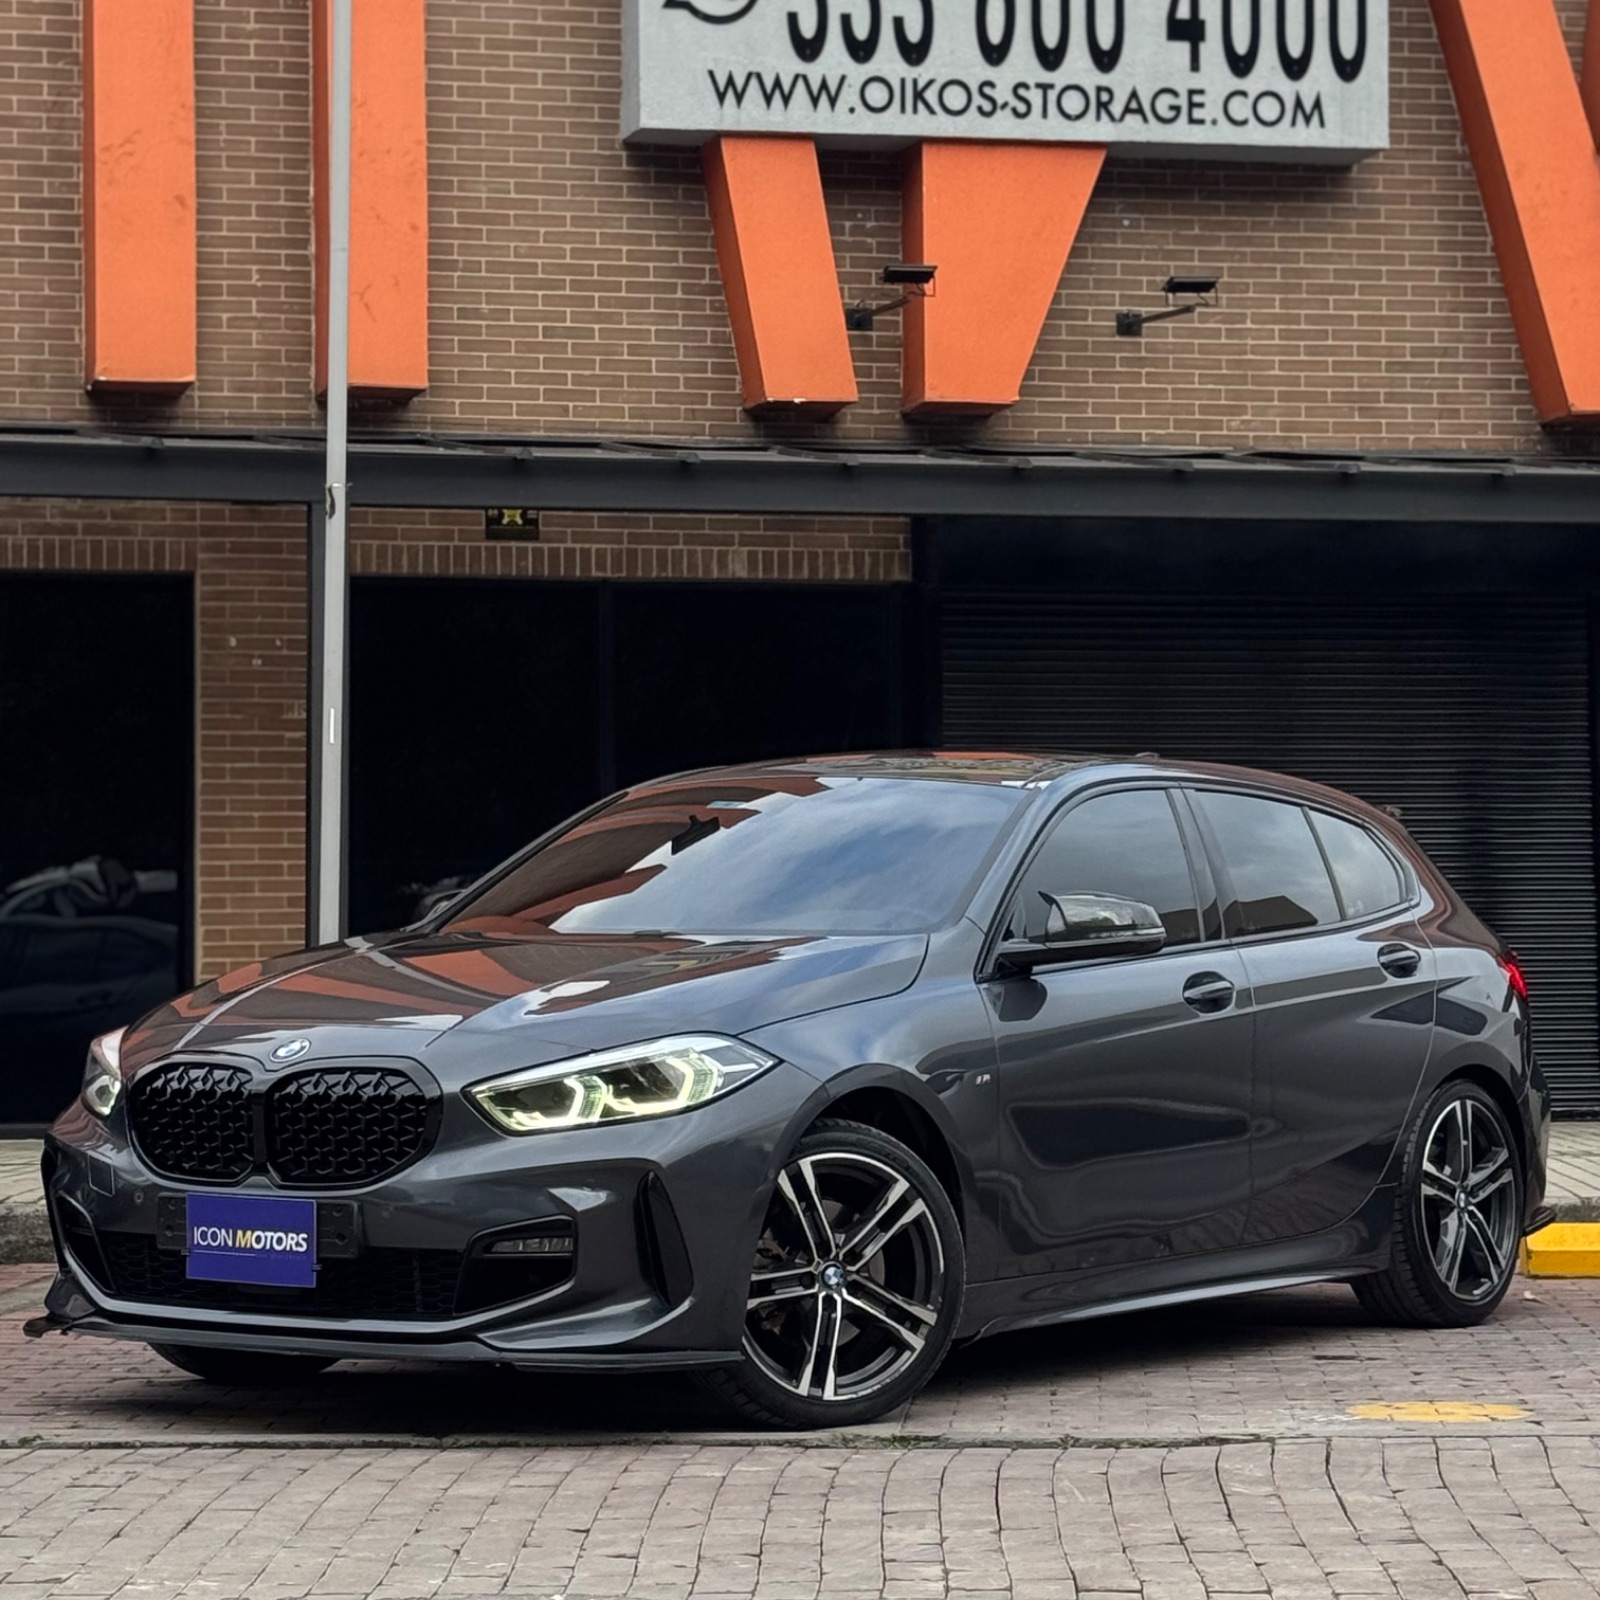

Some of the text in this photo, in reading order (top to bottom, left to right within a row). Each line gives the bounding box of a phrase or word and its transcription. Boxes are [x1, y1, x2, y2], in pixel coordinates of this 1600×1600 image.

[707, 69, 1326, 129] WWW.OIKOS-STORAGE.COM
[193, 1226, 309, 1253] ICON MOTORS
